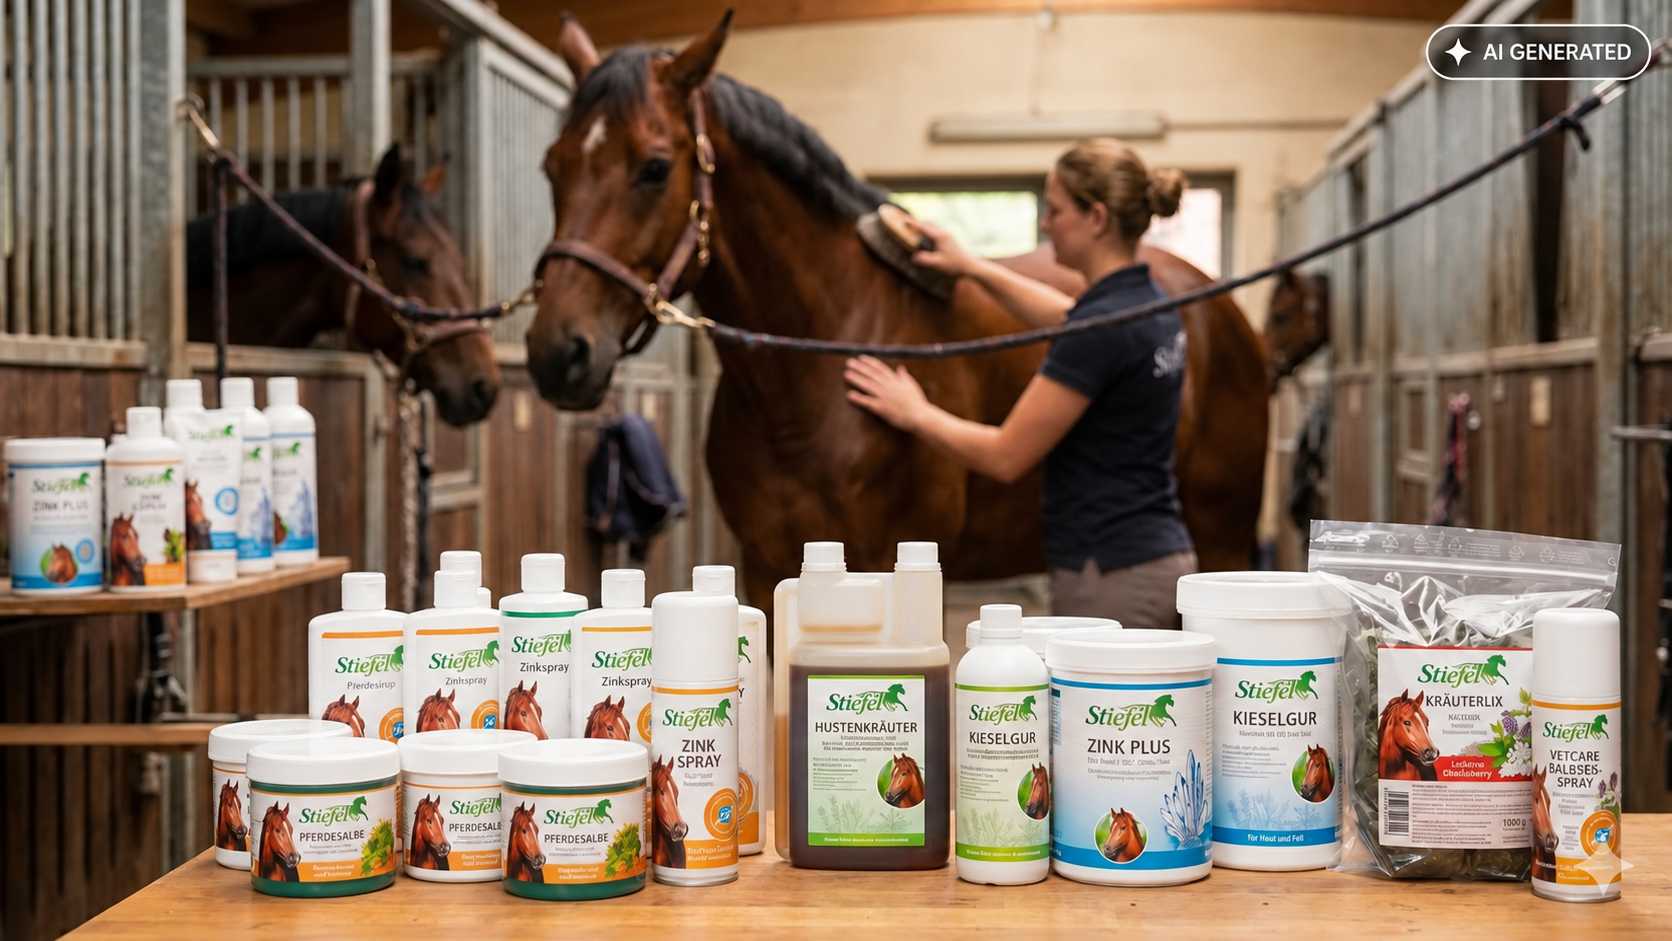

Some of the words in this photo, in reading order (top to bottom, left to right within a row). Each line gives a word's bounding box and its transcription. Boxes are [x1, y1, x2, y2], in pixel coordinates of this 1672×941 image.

[519, 662, 569, 674] Zinkspray
[601, 675, 652, 688] Zinkspray
[1425, 693, 1503, 708] KRÄUTERLIX
[1233, 710, 1317, 726] KIESELGUR
[815, 720, 918, 733] HUSTENKRÄUTER
[969, 731, 1036, 745] KIESELGUR
[682, 739, 716, 753] ZINK
[1087, 738, 1125, 754] ZINK
[1131, 739, 1171, 755] PLUS
[677, 754, 722, 768] SPRAY
[1550, 750, 1600, 762] VETCARE
[1557, 776, 1594, 788] SPRAY
[299, 829, 365, 842] PFERDESALBE
[544, 833, 609, 844] PFERDESALBE
